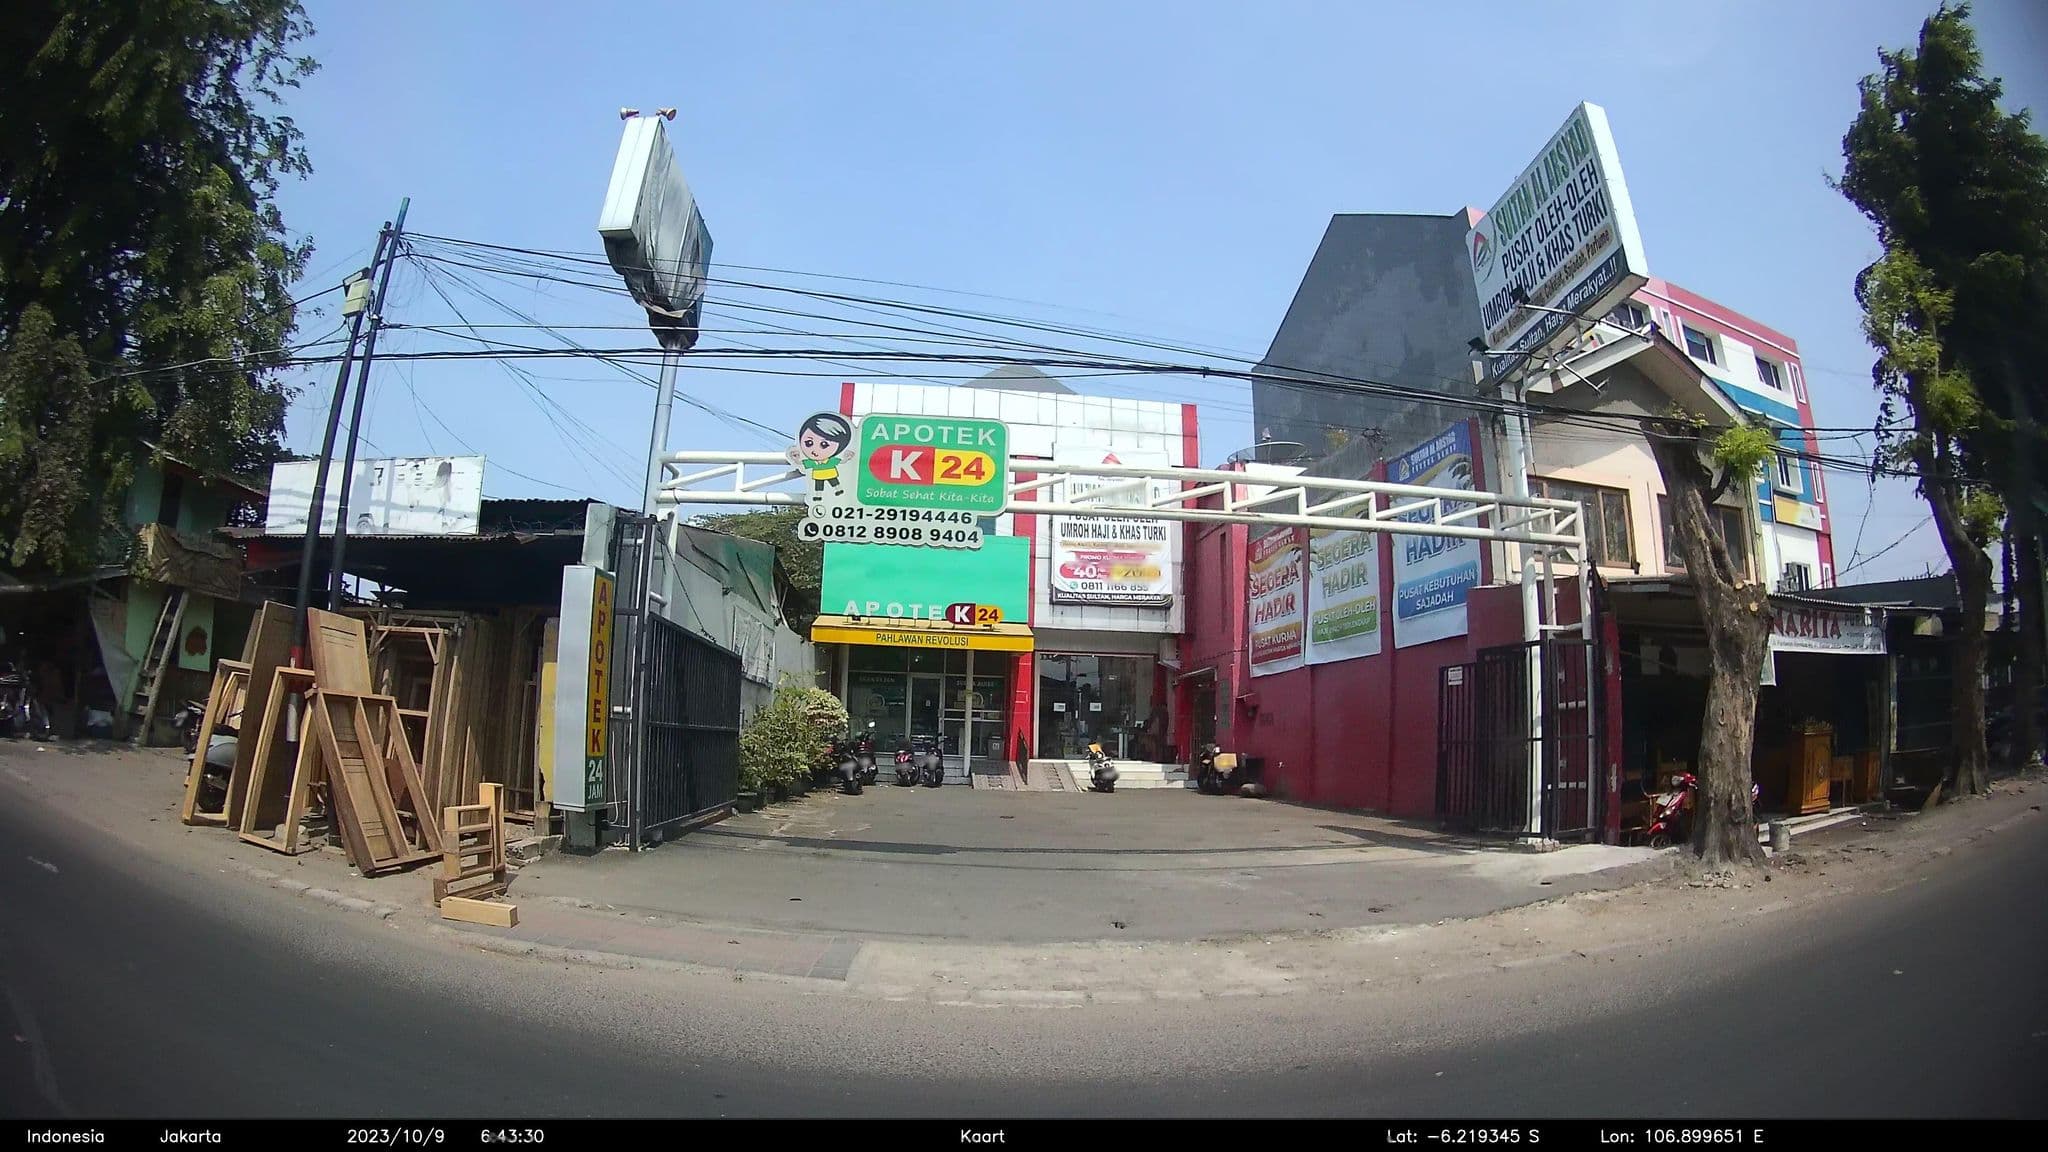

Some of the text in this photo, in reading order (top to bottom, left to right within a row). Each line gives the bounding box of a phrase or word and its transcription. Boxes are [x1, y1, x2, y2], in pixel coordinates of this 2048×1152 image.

[1502, 159, 1599, 279] PUSAT OLEH-OLEH
[1536, 252, 1546, 280] &
[1544, 223, 1575, 272] KHAS
[1572, 188, 1608, 243] TURKI
[1520, 326, 1547, 354] Sultan,
[870, 421, 997, 447] APOTEK
[889, 448, 987, 481] K 24
[865, 486, 995, 504] Sobat Sehat Kita-Kita
[831, 506, 973, 525] 021-29194446
[822, 524, 980, 545] 0812 8908 9404
[1060, 522, 1167, 541] UMROH HAJI & KHAS TURKI
[1316, 531, 1374, 572] SEGERA
[1081, 581, 1103, 591] 0811
[1250, 561, 1300, 600] SEGERA
[1321, 561, 1369, 599] HADIR
[1400, 567, 1476, 600] PUSAT KEBUTUHAN
[1254, 591, 1297, 625] HADIR
[1416, 591, 1455, 611] SAJADAH
[978, 608, 1000, 622] 24
[1769, 607, 1842, 640] NARITA
[876, 633, 969, 647] PAHLAWAN REVOLUSI
[1273, 629, 1298, 645] KURMA
[591, 581, 608, 753] APOTEK
[588, 759, 603, 783] 24
[587, 783, 603, 800] JAM
